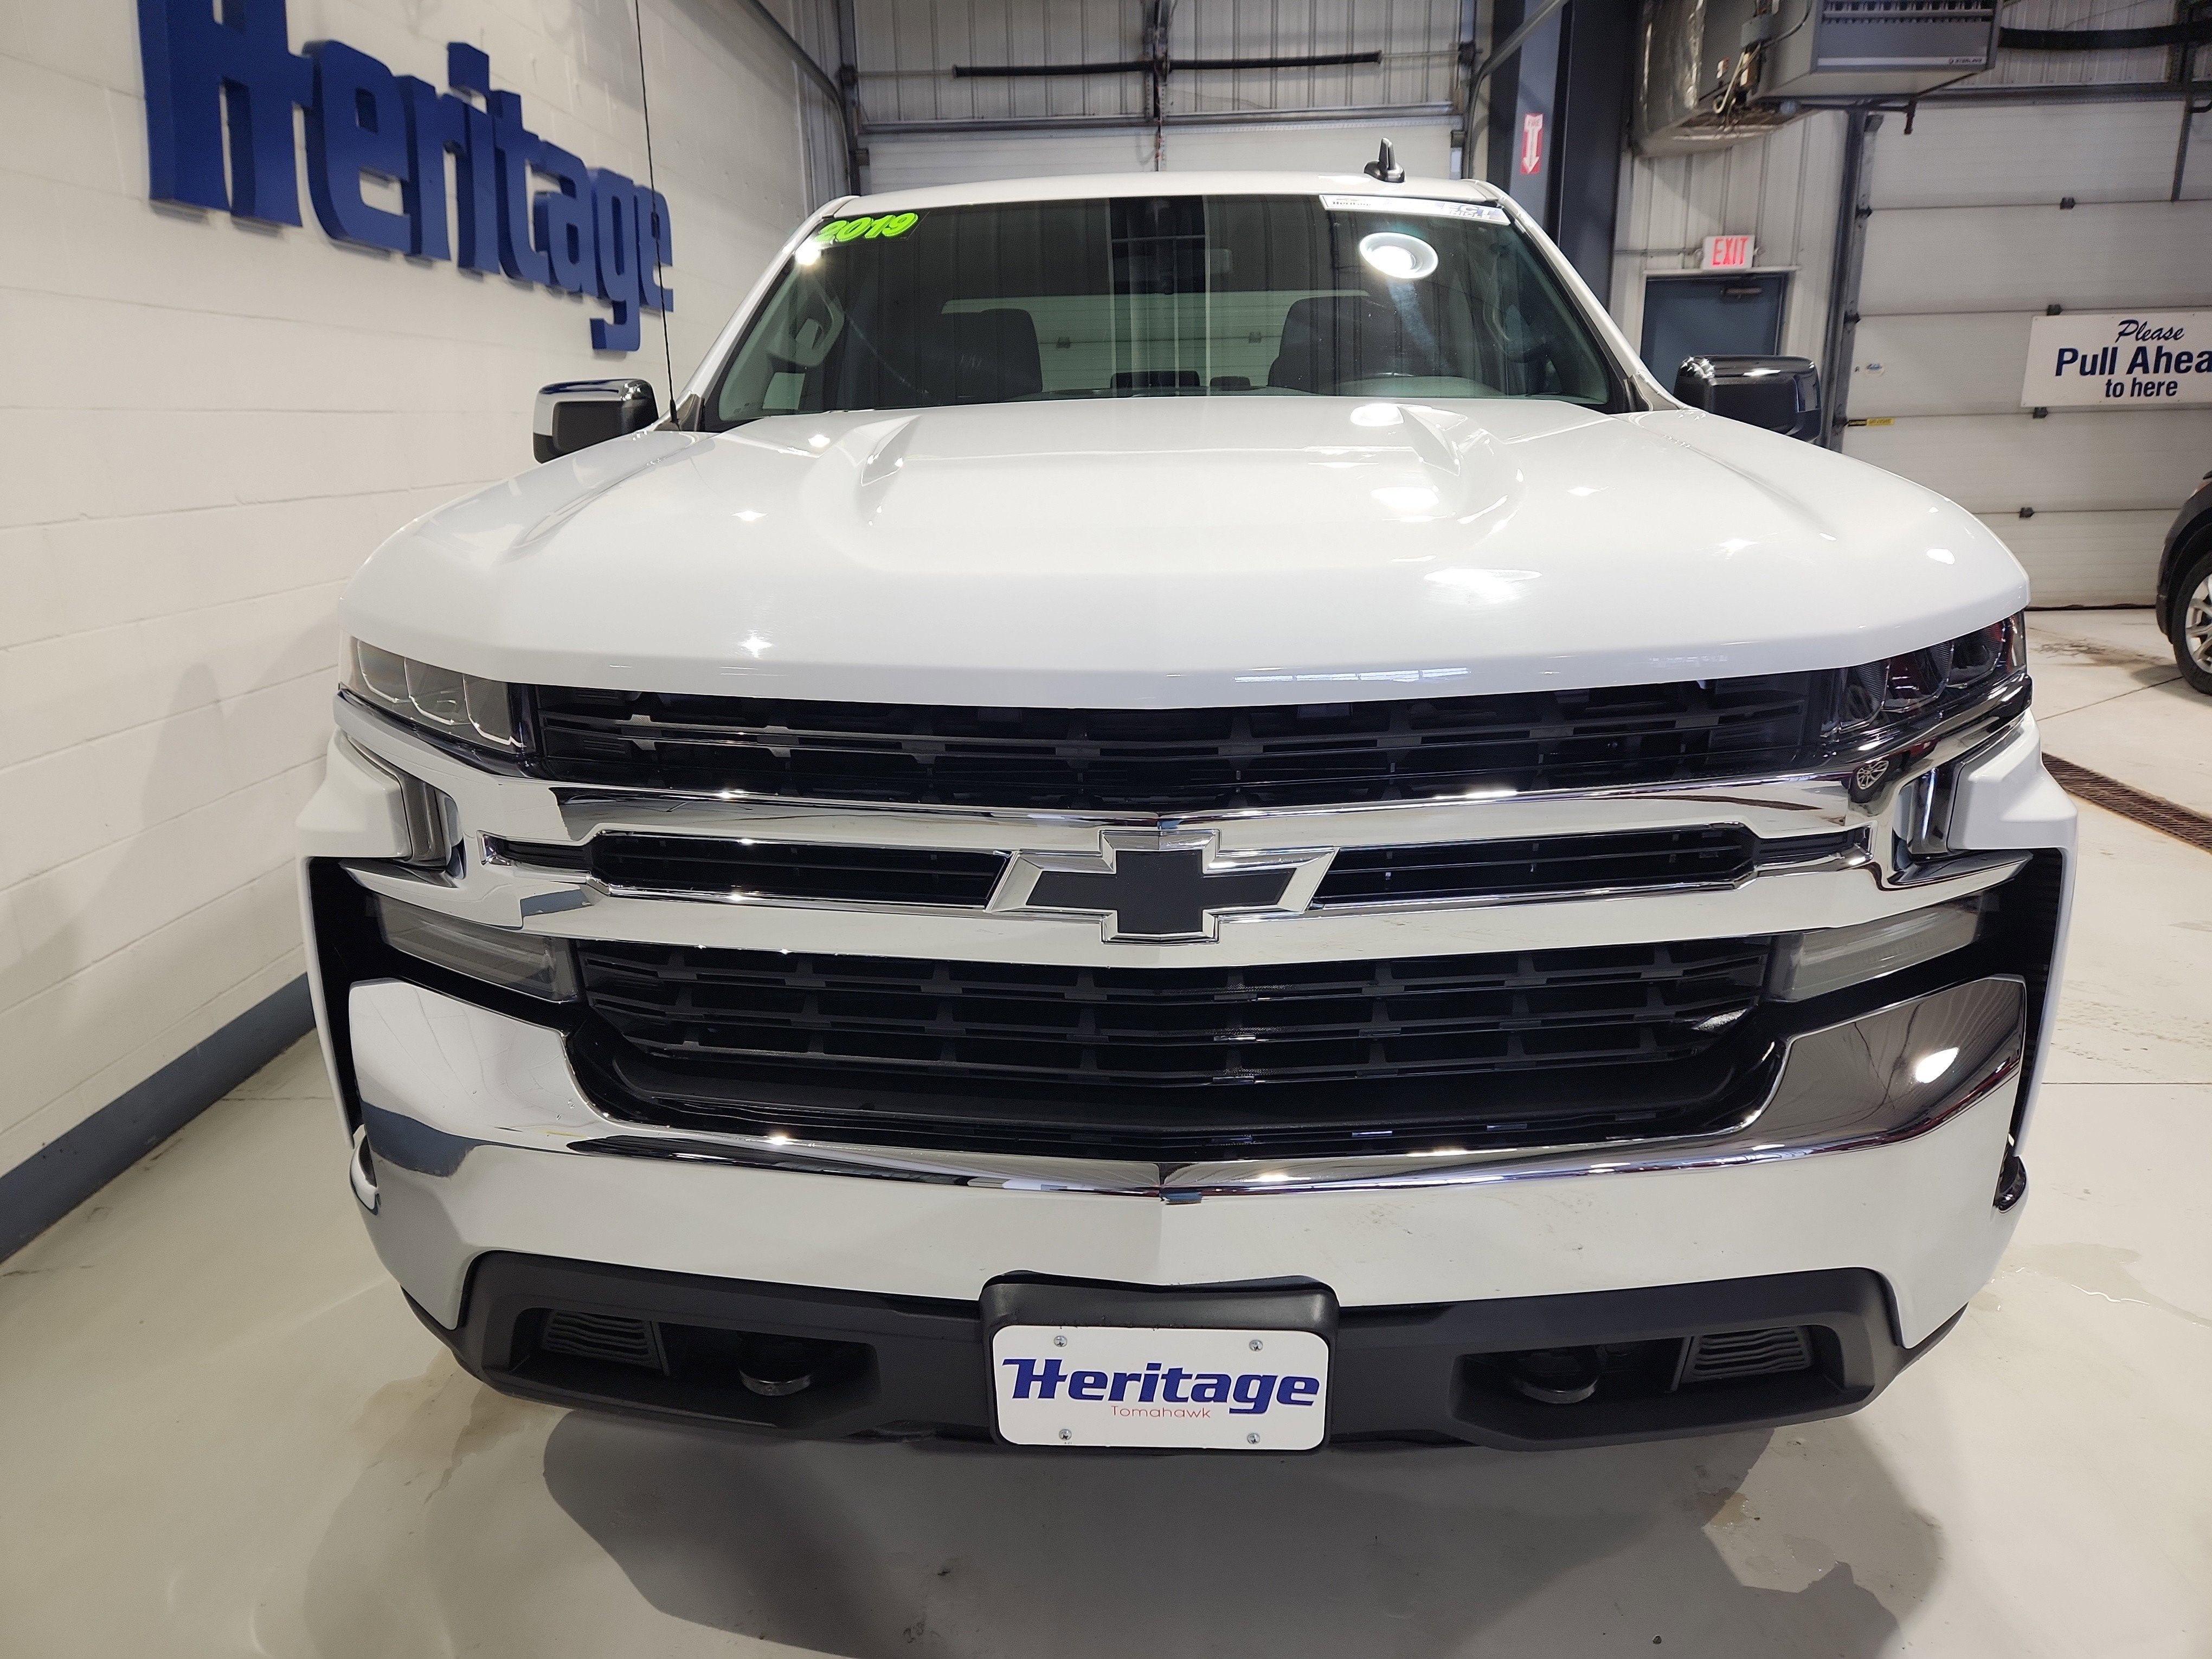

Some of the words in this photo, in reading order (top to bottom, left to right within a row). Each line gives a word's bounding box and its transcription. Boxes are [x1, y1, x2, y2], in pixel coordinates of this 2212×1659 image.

[137, 0, 674, 351] Heritage
[813, 212, 918, 243] 2019
[1712, 236, 1749, 266] EXIT
[2114, 318, 2185, 343] Please
[2055, 346, 2118, 376] Pull
[2105, 378, 2124, 397] to
[2130, 377, 2178, 397] here
[1002, 1358, 1320, 1414] Heritage
[1111, 1405, 1211, 1418] Tomahawk
